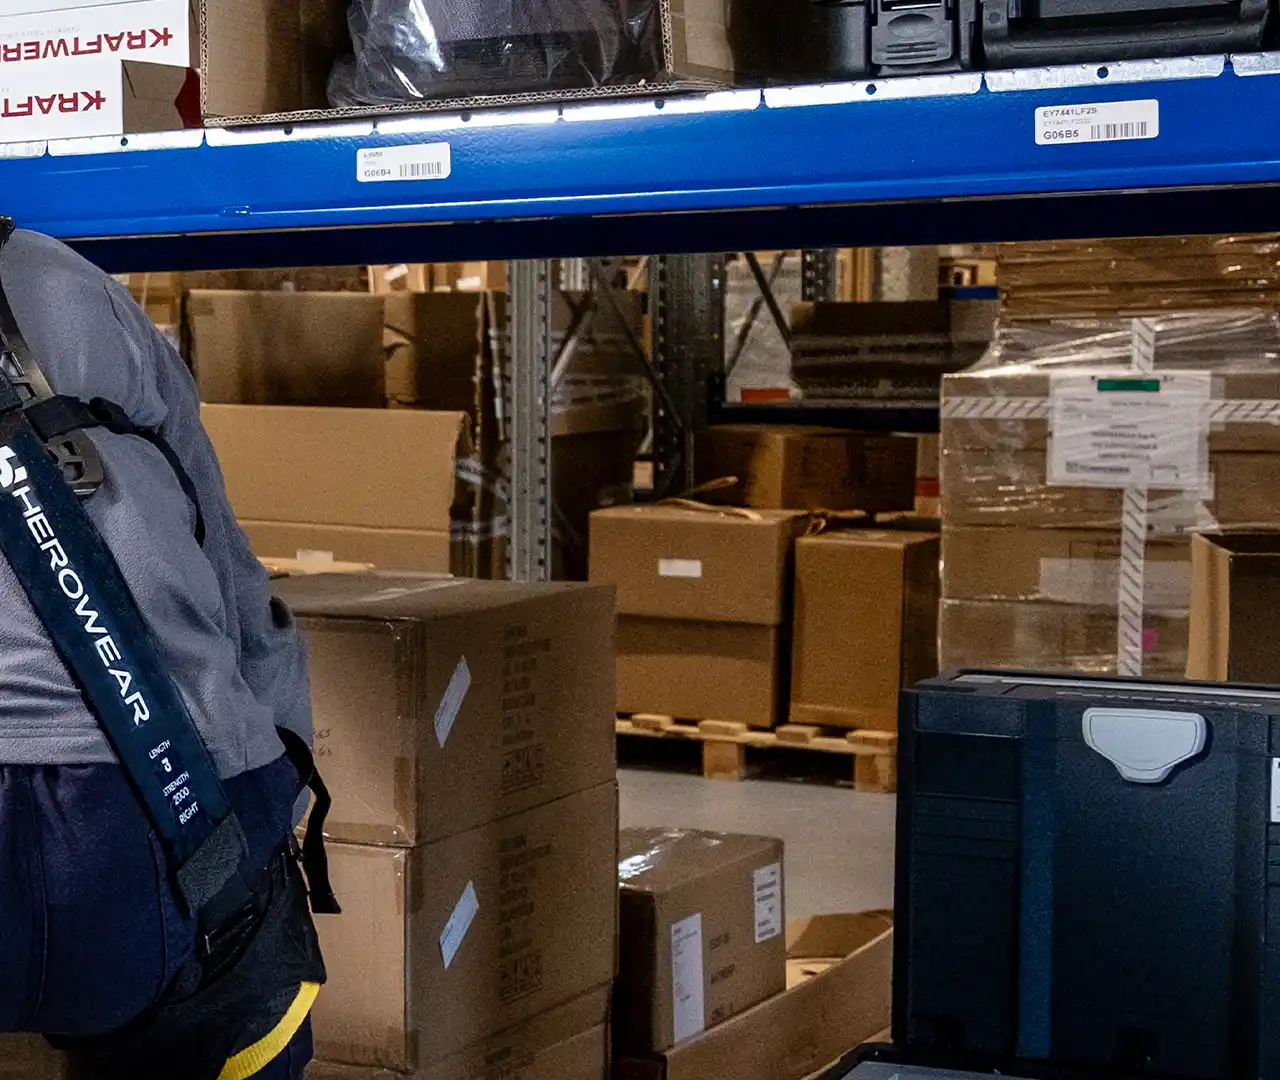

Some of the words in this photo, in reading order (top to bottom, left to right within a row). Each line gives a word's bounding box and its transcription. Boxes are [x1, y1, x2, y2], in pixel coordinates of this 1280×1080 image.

[1043, 130, 1079, 140] G06B5
[12, 485, 151, 726] HEROWEAR
[148, 740, 171, 759] LENGTH
[162, 770, 190, 797] STRENGTH
[173, 786, 190, 806] 2000
[179, 801, 199, 825] RIGHT
